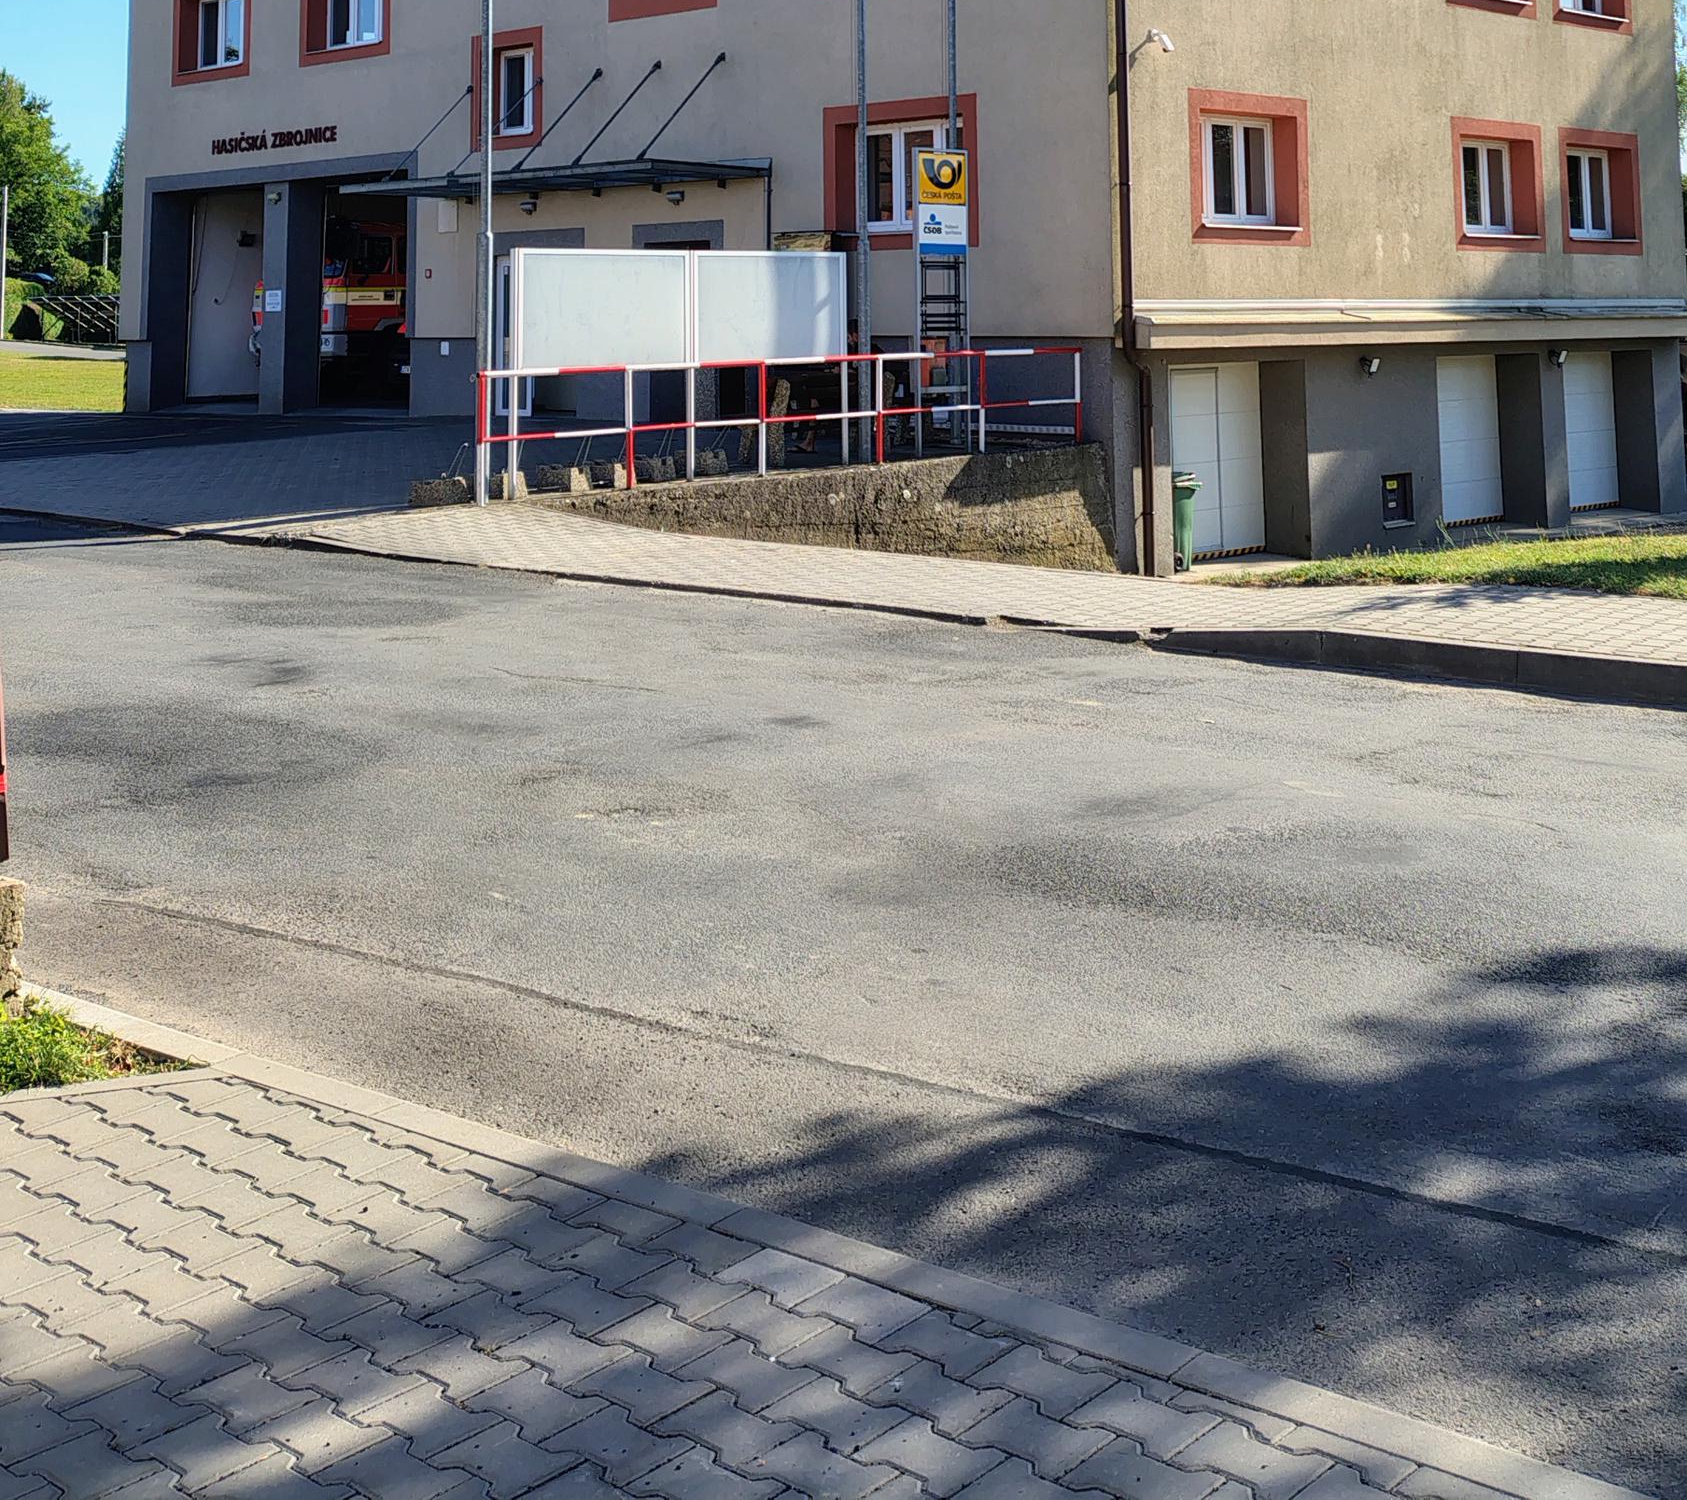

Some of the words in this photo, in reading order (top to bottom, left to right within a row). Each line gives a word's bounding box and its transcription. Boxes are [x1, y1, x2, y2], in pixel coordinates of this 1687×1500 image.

[211, 129, 268, 155] HASIČSKÁ
[270, 125, 337, 149] ZBROJNICE
[921, 190, 942, 199] ČESKÁ
[943, 191, 962, 200] POŠTA
